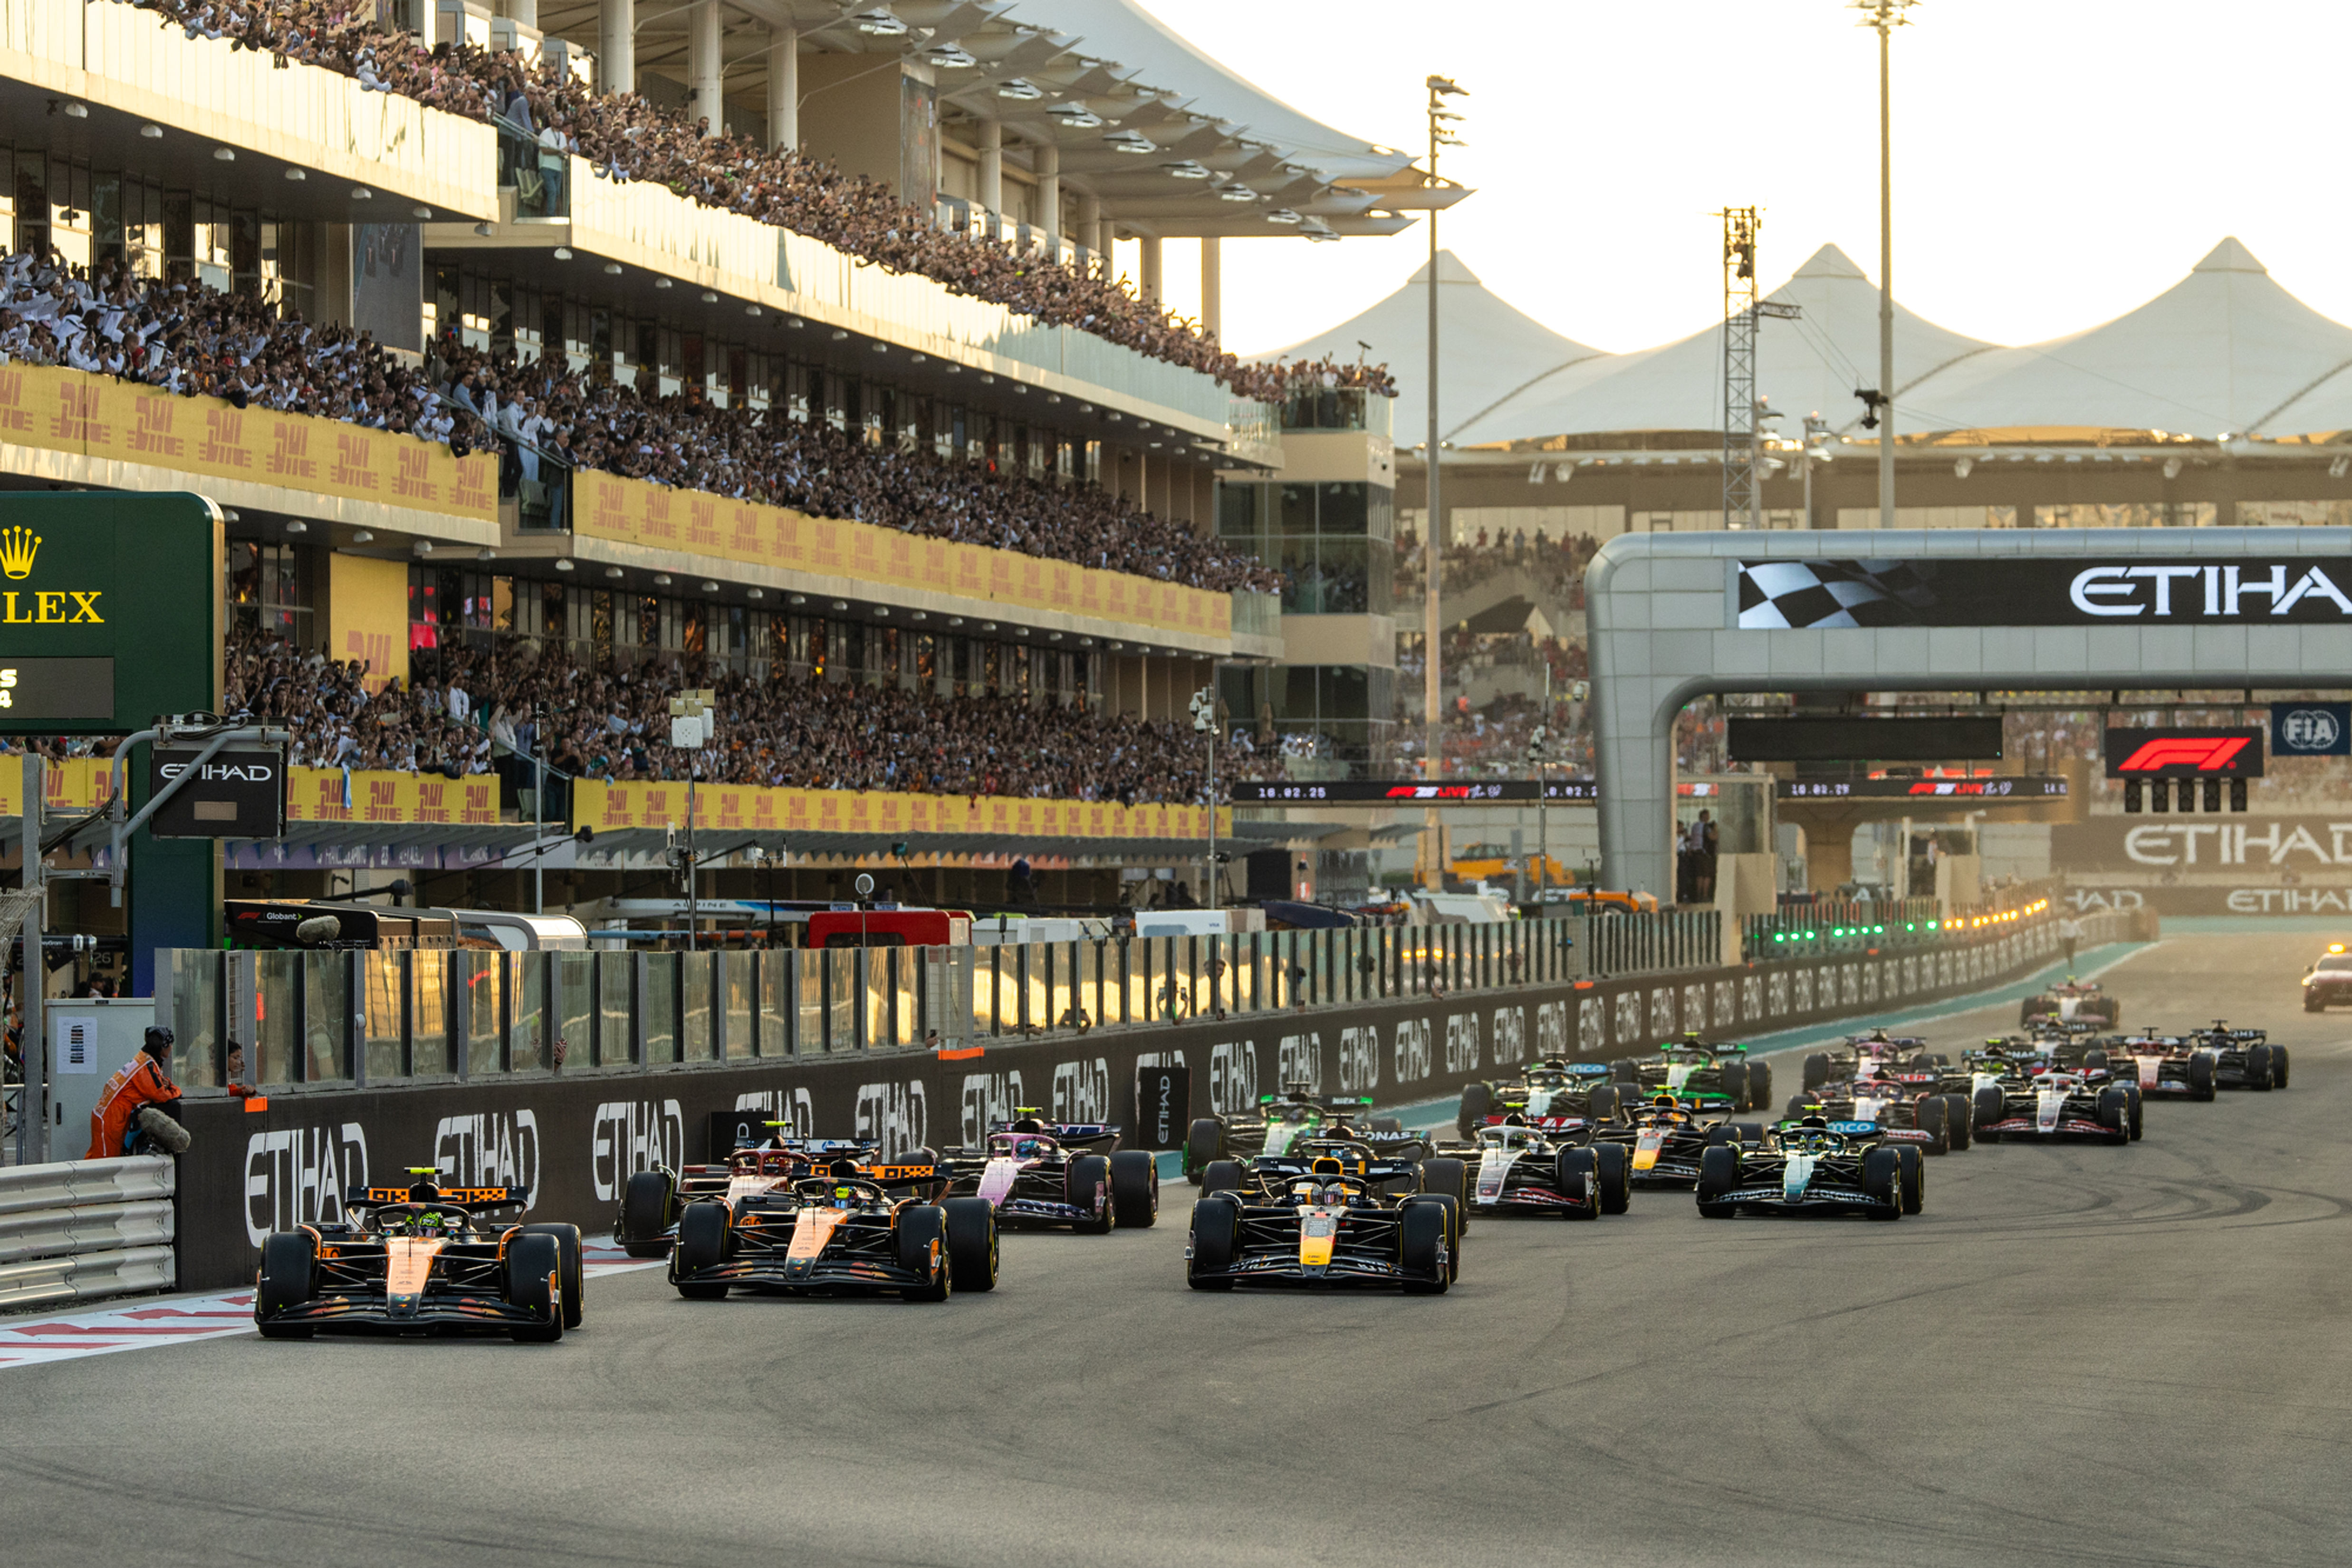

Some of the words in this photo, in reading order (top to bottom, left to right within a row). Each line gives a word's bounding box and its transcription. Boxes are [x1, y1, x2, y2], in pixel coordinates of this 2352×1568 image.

[51, 382, 110, 445] DHL
[127, 396, 184, 457] DHL
[199, 409, 252, 468] DHL
[266, 423, 317, 478] DHL
[330, 433, 379, 490] DHL
[392, 446, 437, 501] DHL
[449, 457, 492, 511] DHL
[2, 592, 105, 623] LEX
[2069, 565, 2352, 616] ETIHA
[0, 669, 18, 688] S
[2118, 738, 2252, 770] F1
[365, 781, 402, 821] DHL
[413, 783, 450, 822] DHL
[461, 785, 495, 823] DHL
[602, 790, 633, 826] DHL
[642, 791, 672, 826] DHL
[266, 912, 297, 920] Globant
[2227, 888, 2352, 912] ETIHA
[1210, 1040, 1258, 1113] ETIHAD
[593, 1099, 684, 1202] ETIHAD
[244, 1122, 369, 1248] ETIHAD
